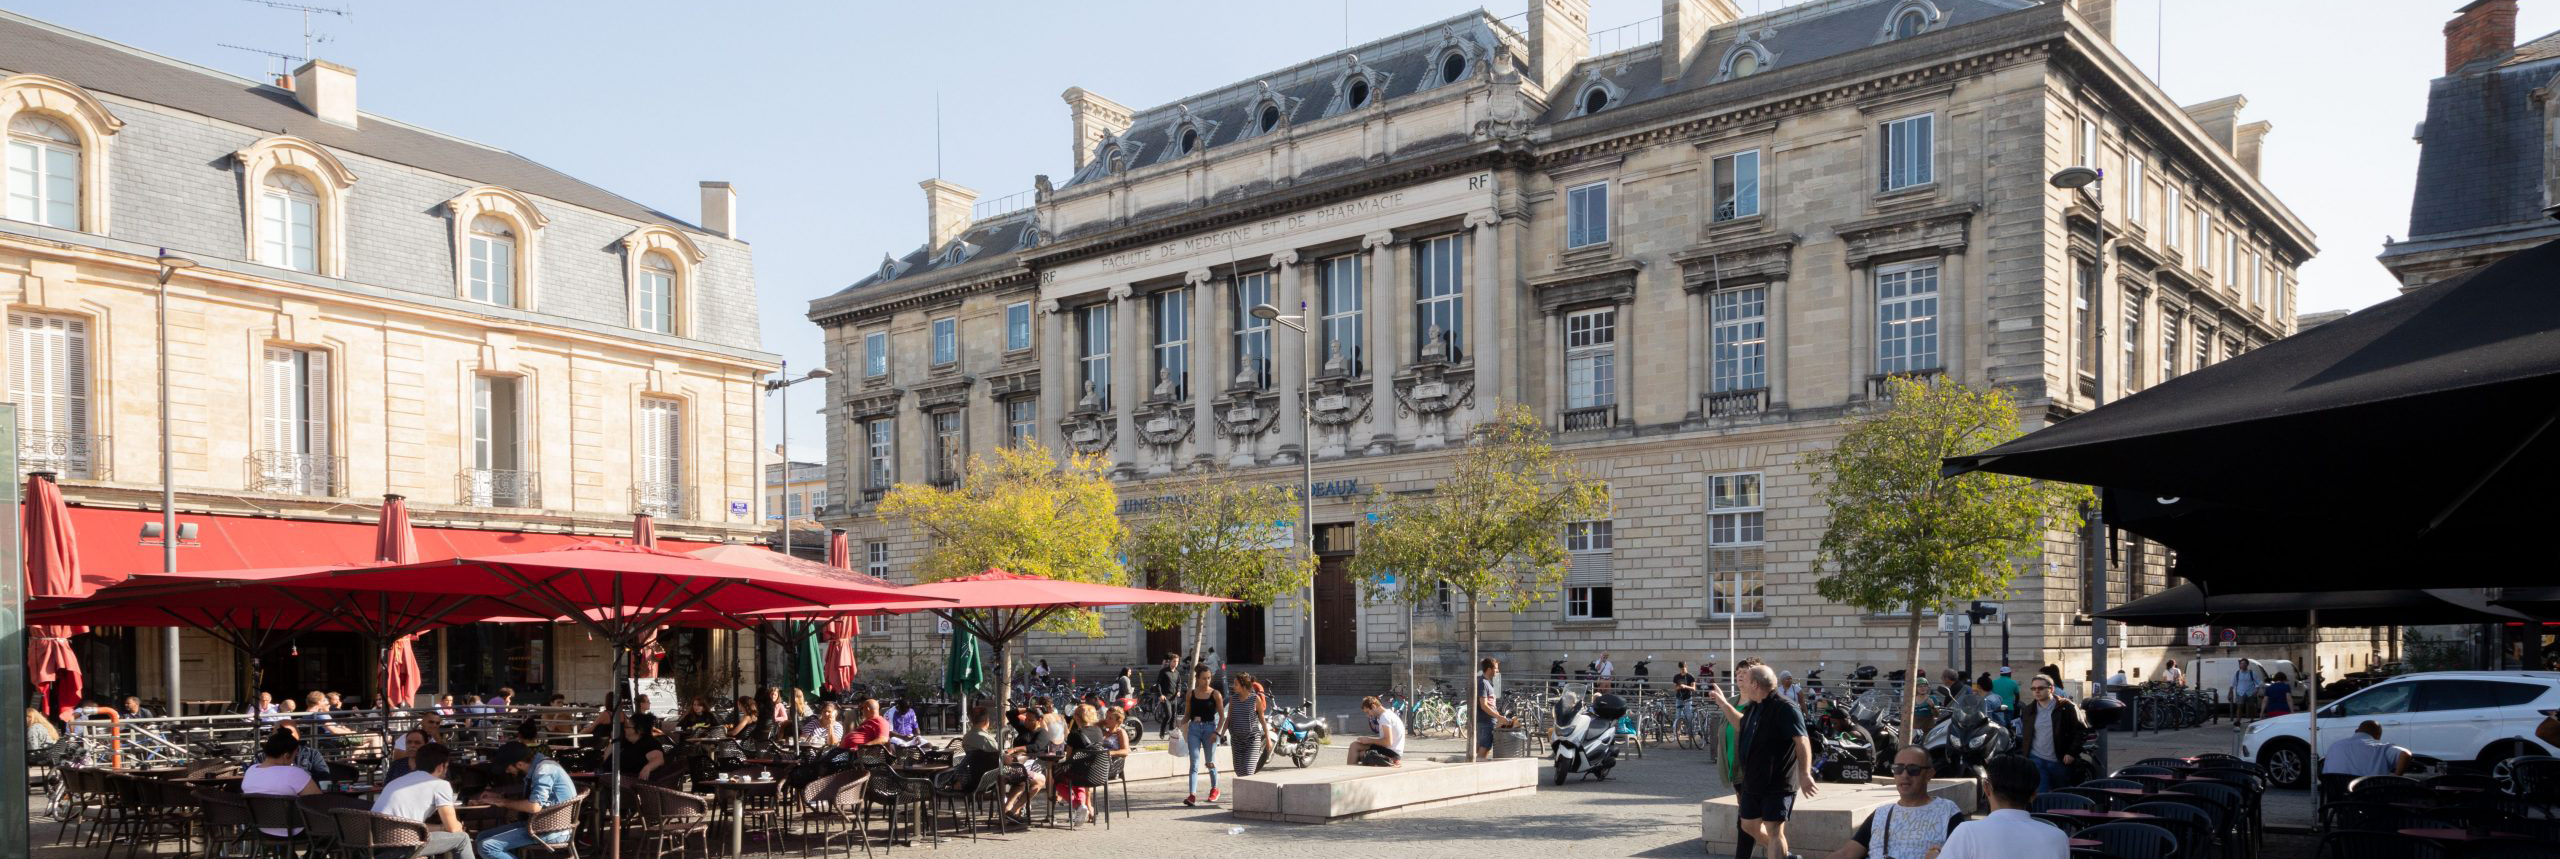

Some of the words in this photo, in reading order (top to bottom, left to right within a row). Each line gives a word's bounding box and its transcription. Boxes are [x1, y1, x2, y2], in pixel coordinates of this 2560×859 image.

[1468, 173, 1489, 191] RF
[1101, 248, 1151, 271] FACULTE
[1160, 243, 1177, 258] DE
[1261, 221, 1280, 236] ET
[1287, 215, 1306, 230] DE
[1317, 192, 1404, 224] PHARMACIE
[1042, 270, 1057, 284] RF
[1842, 769, 1868, 780] eats
